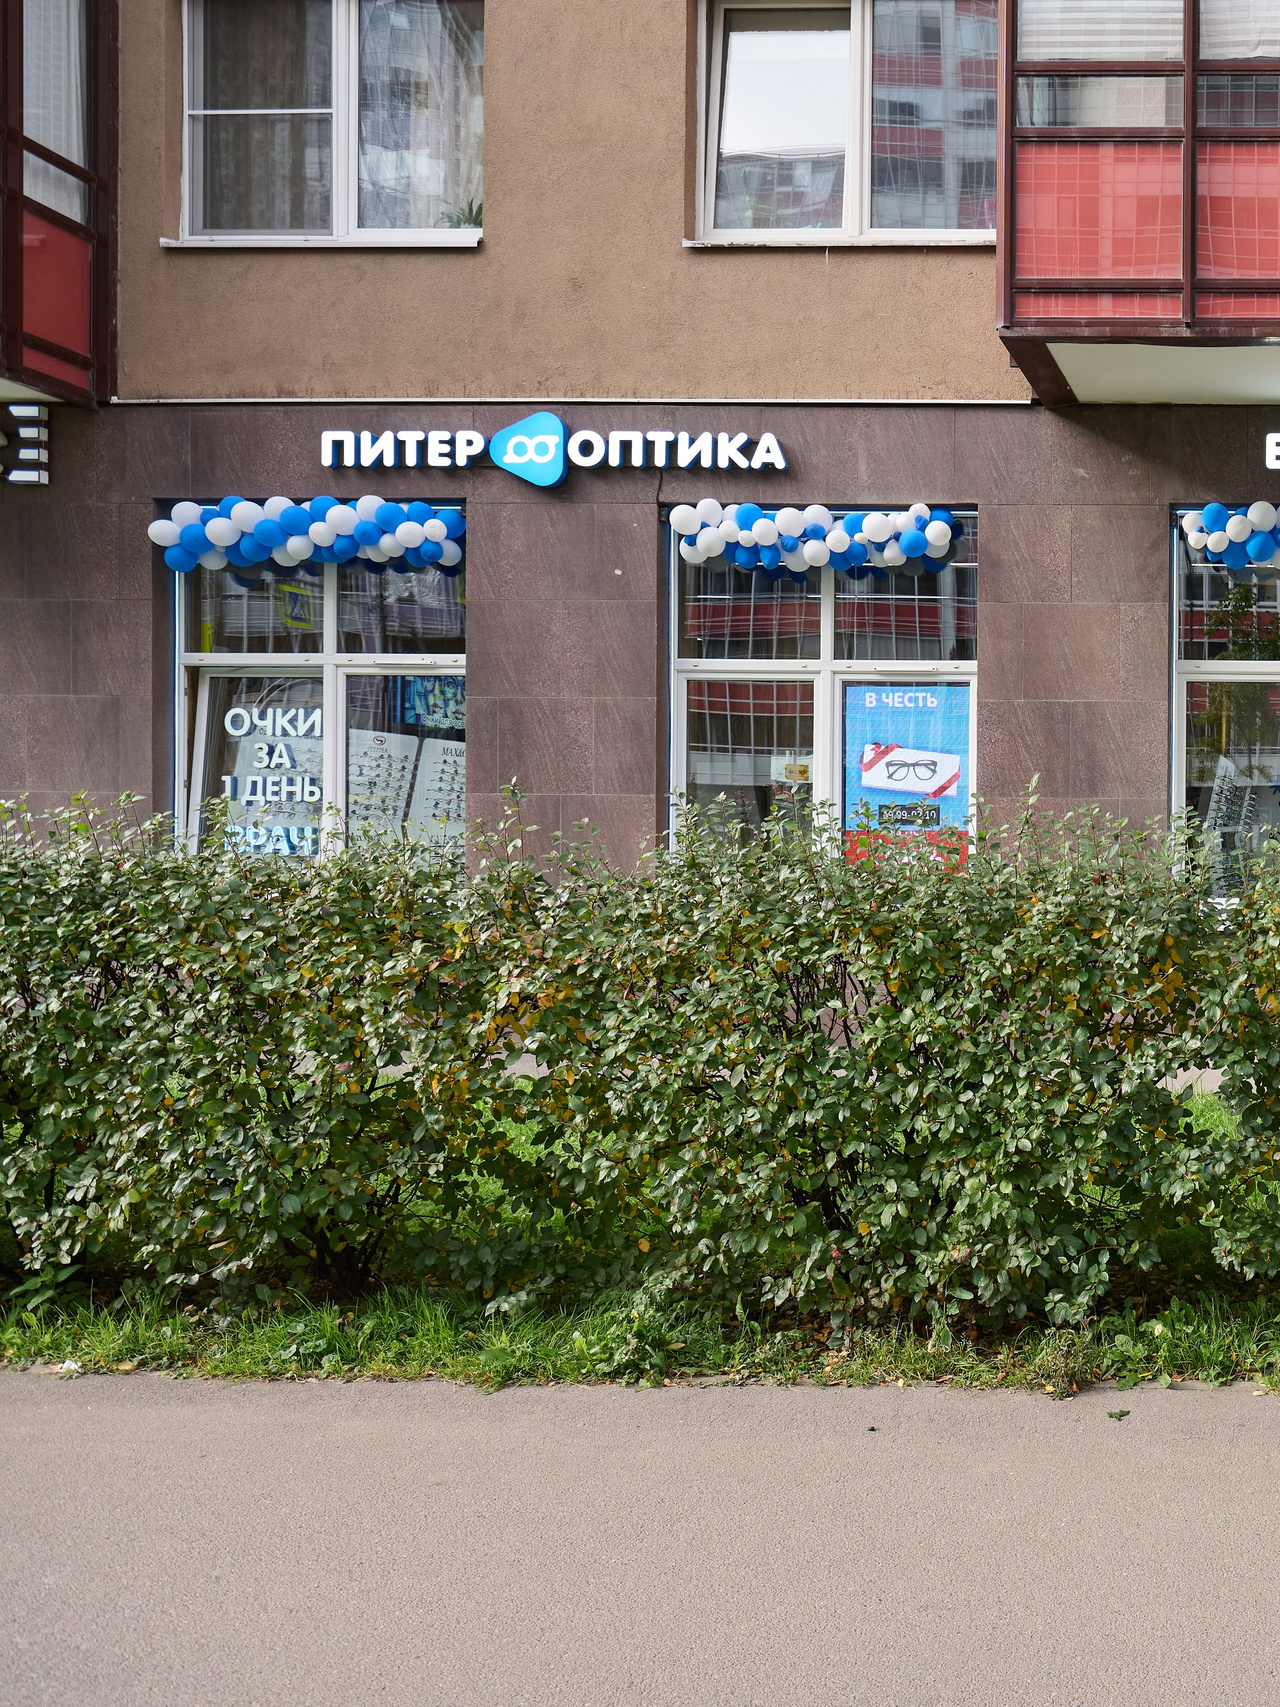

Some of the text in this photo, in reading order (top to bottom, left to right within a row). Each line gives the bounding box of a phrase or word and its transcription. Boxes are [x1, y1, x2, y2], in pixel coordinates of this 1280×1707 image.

[320, 429, 788, 471] ПИТЕР ОПТИКА
[865, 692, 938, 708] В ЧЕСТЬ
[224, 707, 322, 737] ОЧКИ
[252, 742, 292, 769] ЗА
[240, 776, 321, 806] ДЕНЬ
